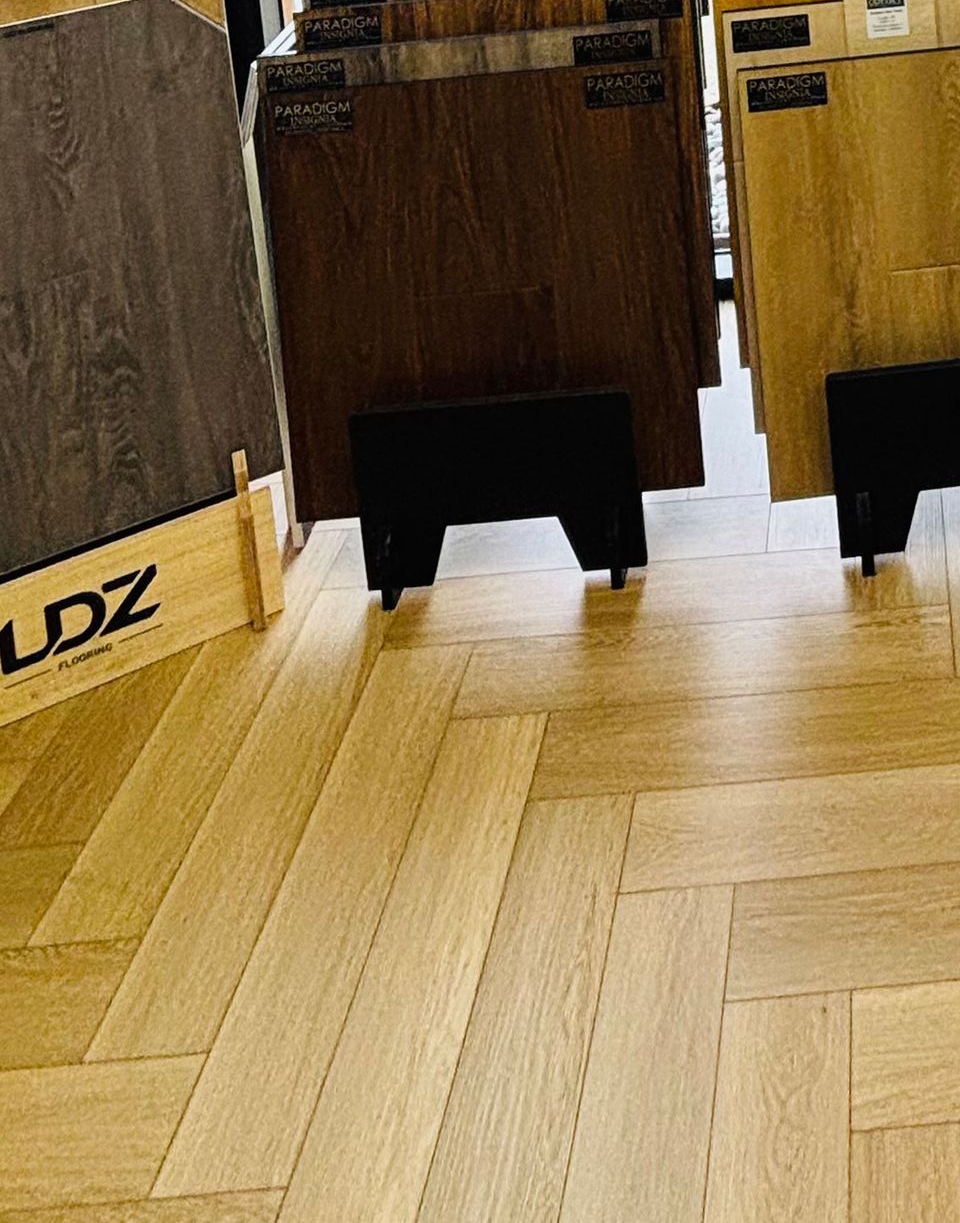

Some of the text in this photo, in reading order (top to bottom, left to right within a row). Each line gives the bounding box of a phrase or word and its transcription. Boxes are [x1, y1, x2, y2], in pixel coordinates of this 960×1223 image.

[305, 17, 378, 32] PARADIGM
[733, 18, 806, 32] PARADIGM
[575, 33, 649, 49] PARADIGM
[267, 61, 343, 77] PARADIGM
[587, 74, 662, 91] PARADIGM
[750, 75, 825, 91] PARADIGM
[275, 102, 350, 117] PARADIGM
[0, 563, 161, 675] UDZ
[58, 643, 113, 671] FLOORING
